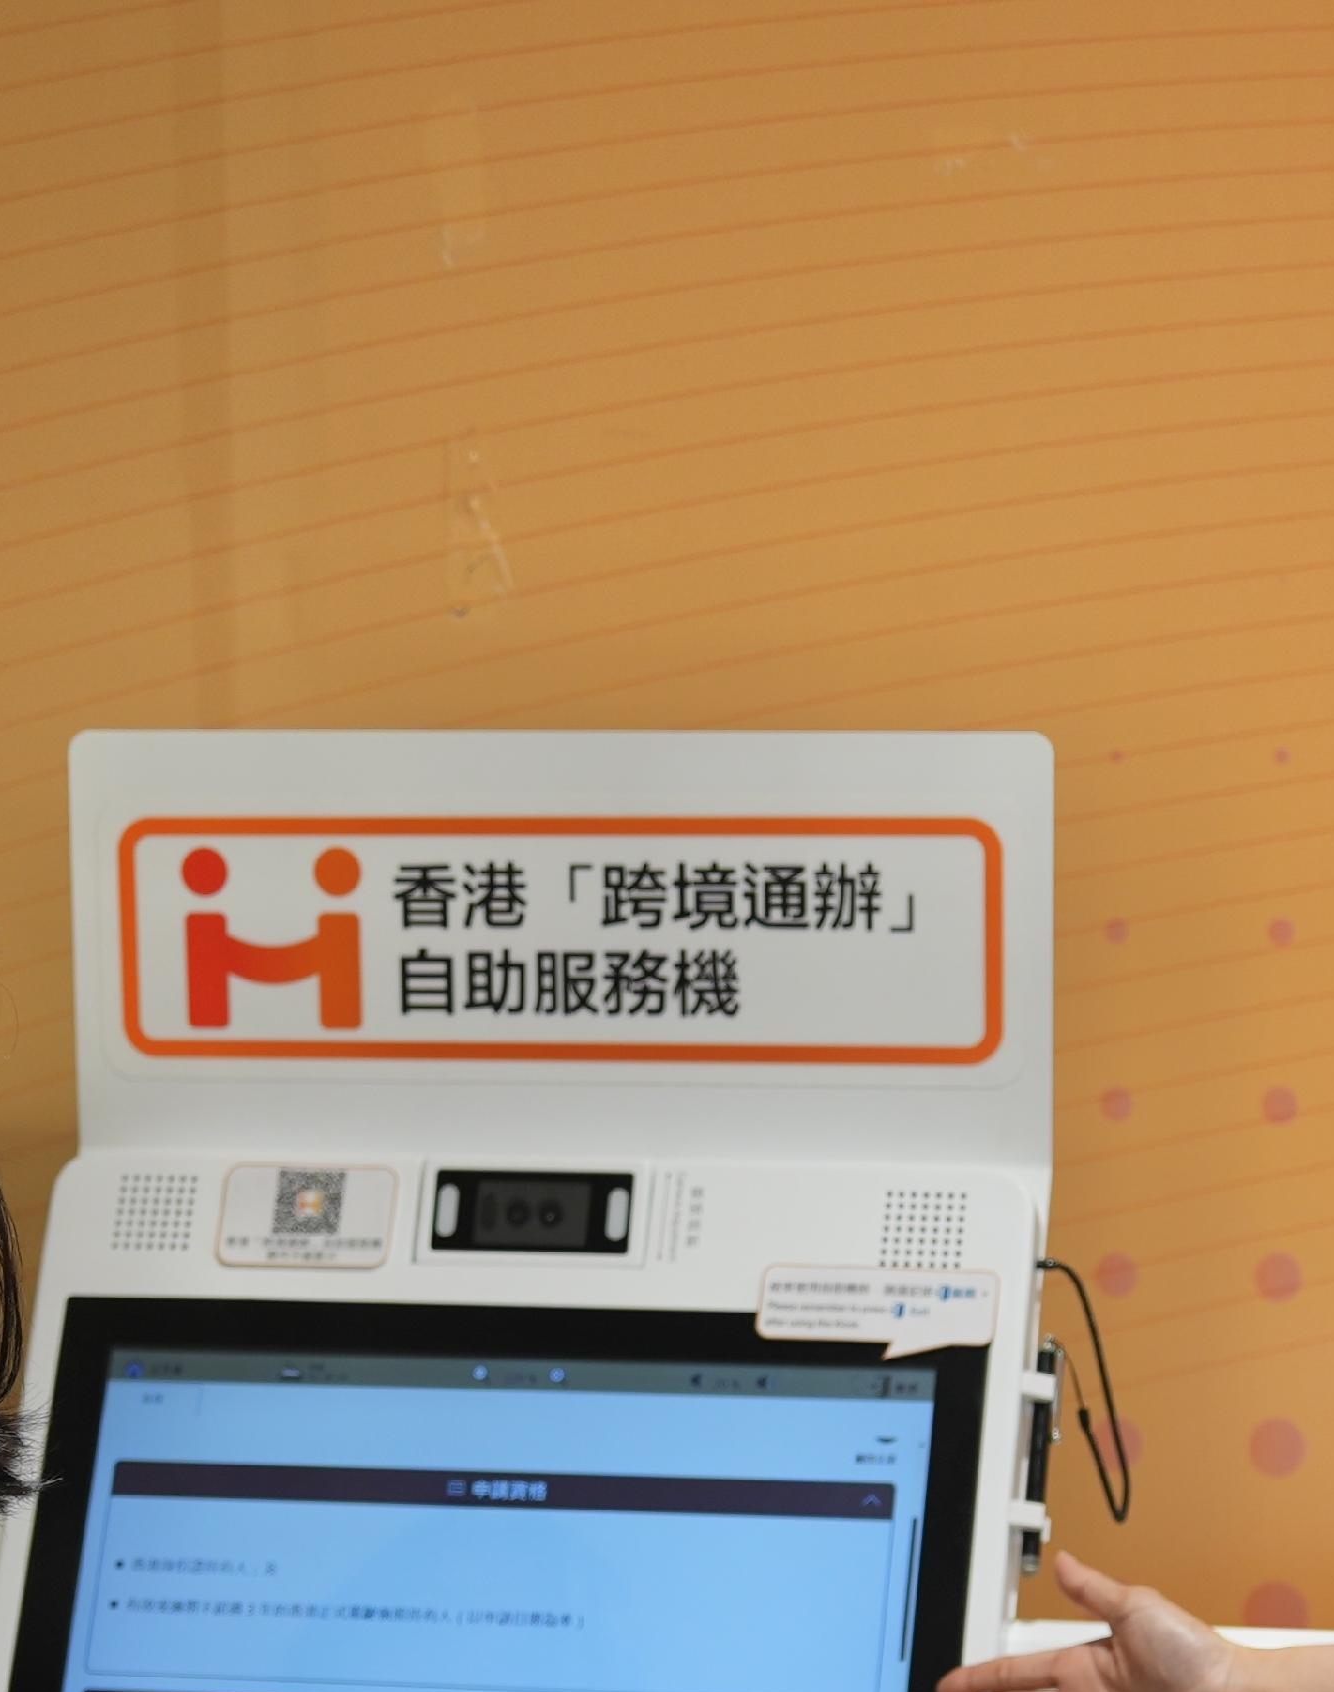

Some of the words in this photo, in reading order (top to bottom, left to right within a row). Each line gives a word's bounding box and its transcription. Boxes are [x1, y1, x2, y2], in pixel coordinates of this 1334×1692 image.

[391, 860, 919, 936] 香港「跨境通辦」
[397, 946, 741, 1020] 自助服務機
